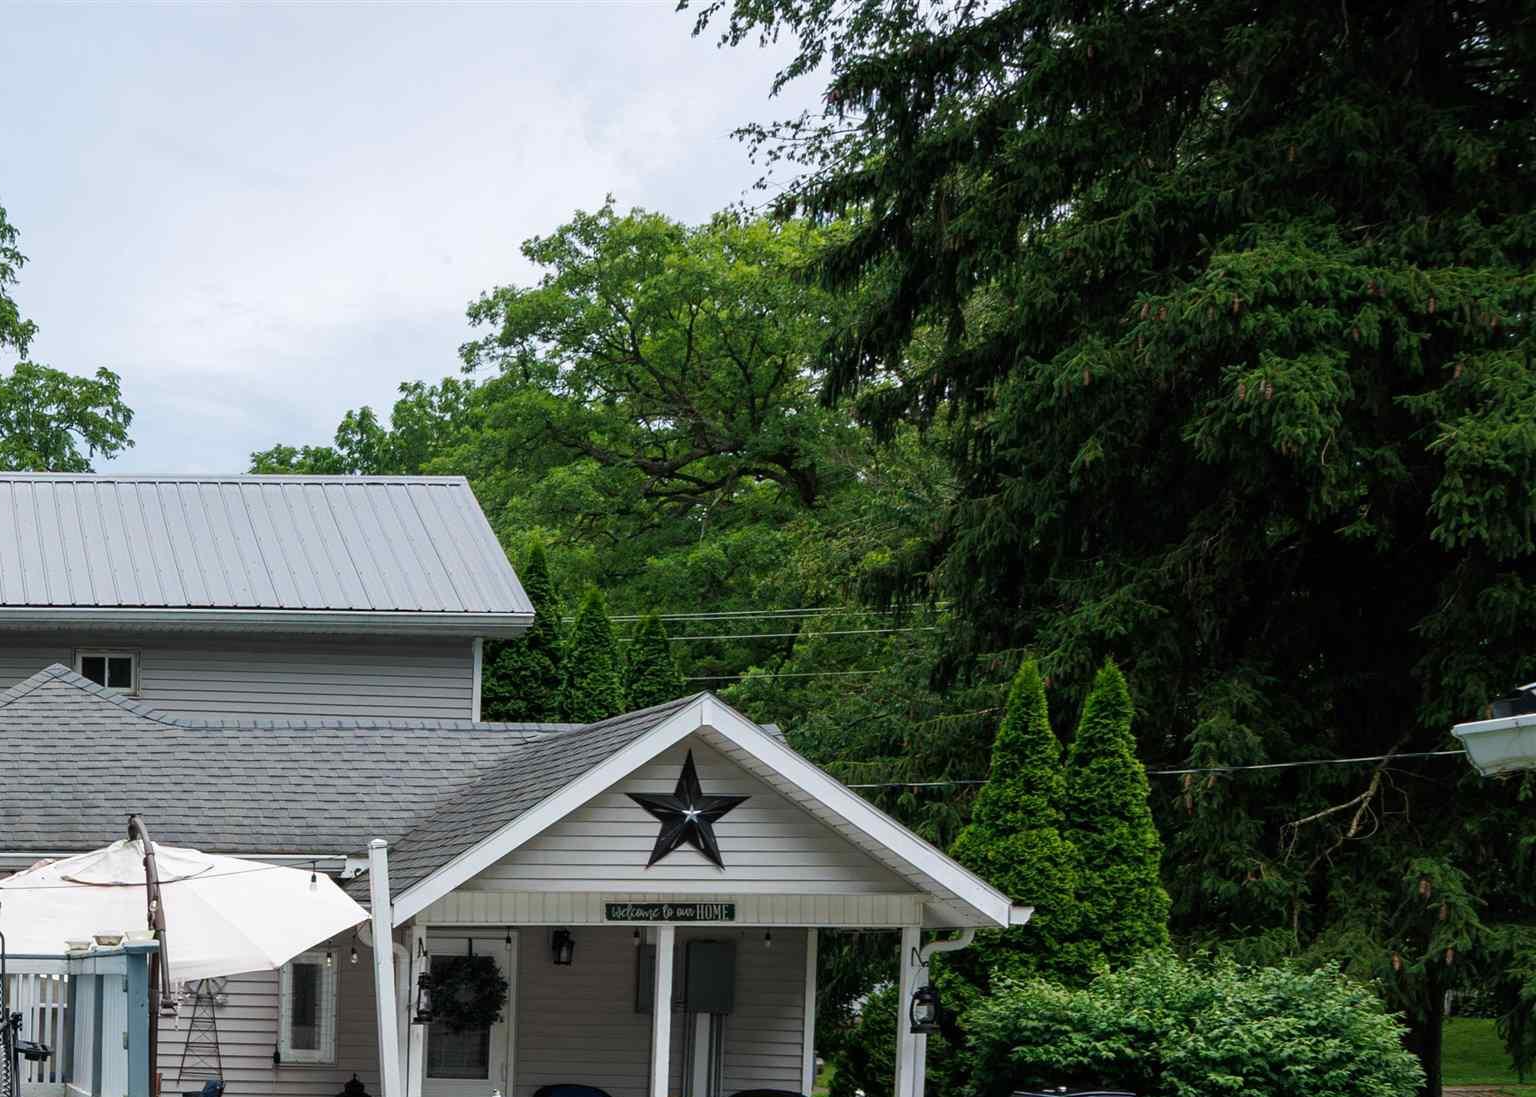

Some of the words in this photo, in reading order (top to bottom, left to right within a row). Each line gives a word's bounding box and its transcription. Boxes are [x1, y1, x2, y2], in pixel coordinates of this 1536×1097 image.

[662, 904, 673, 919] to
[676, 907, 695, 918] our
[696, 904, 729, 920] HOME
